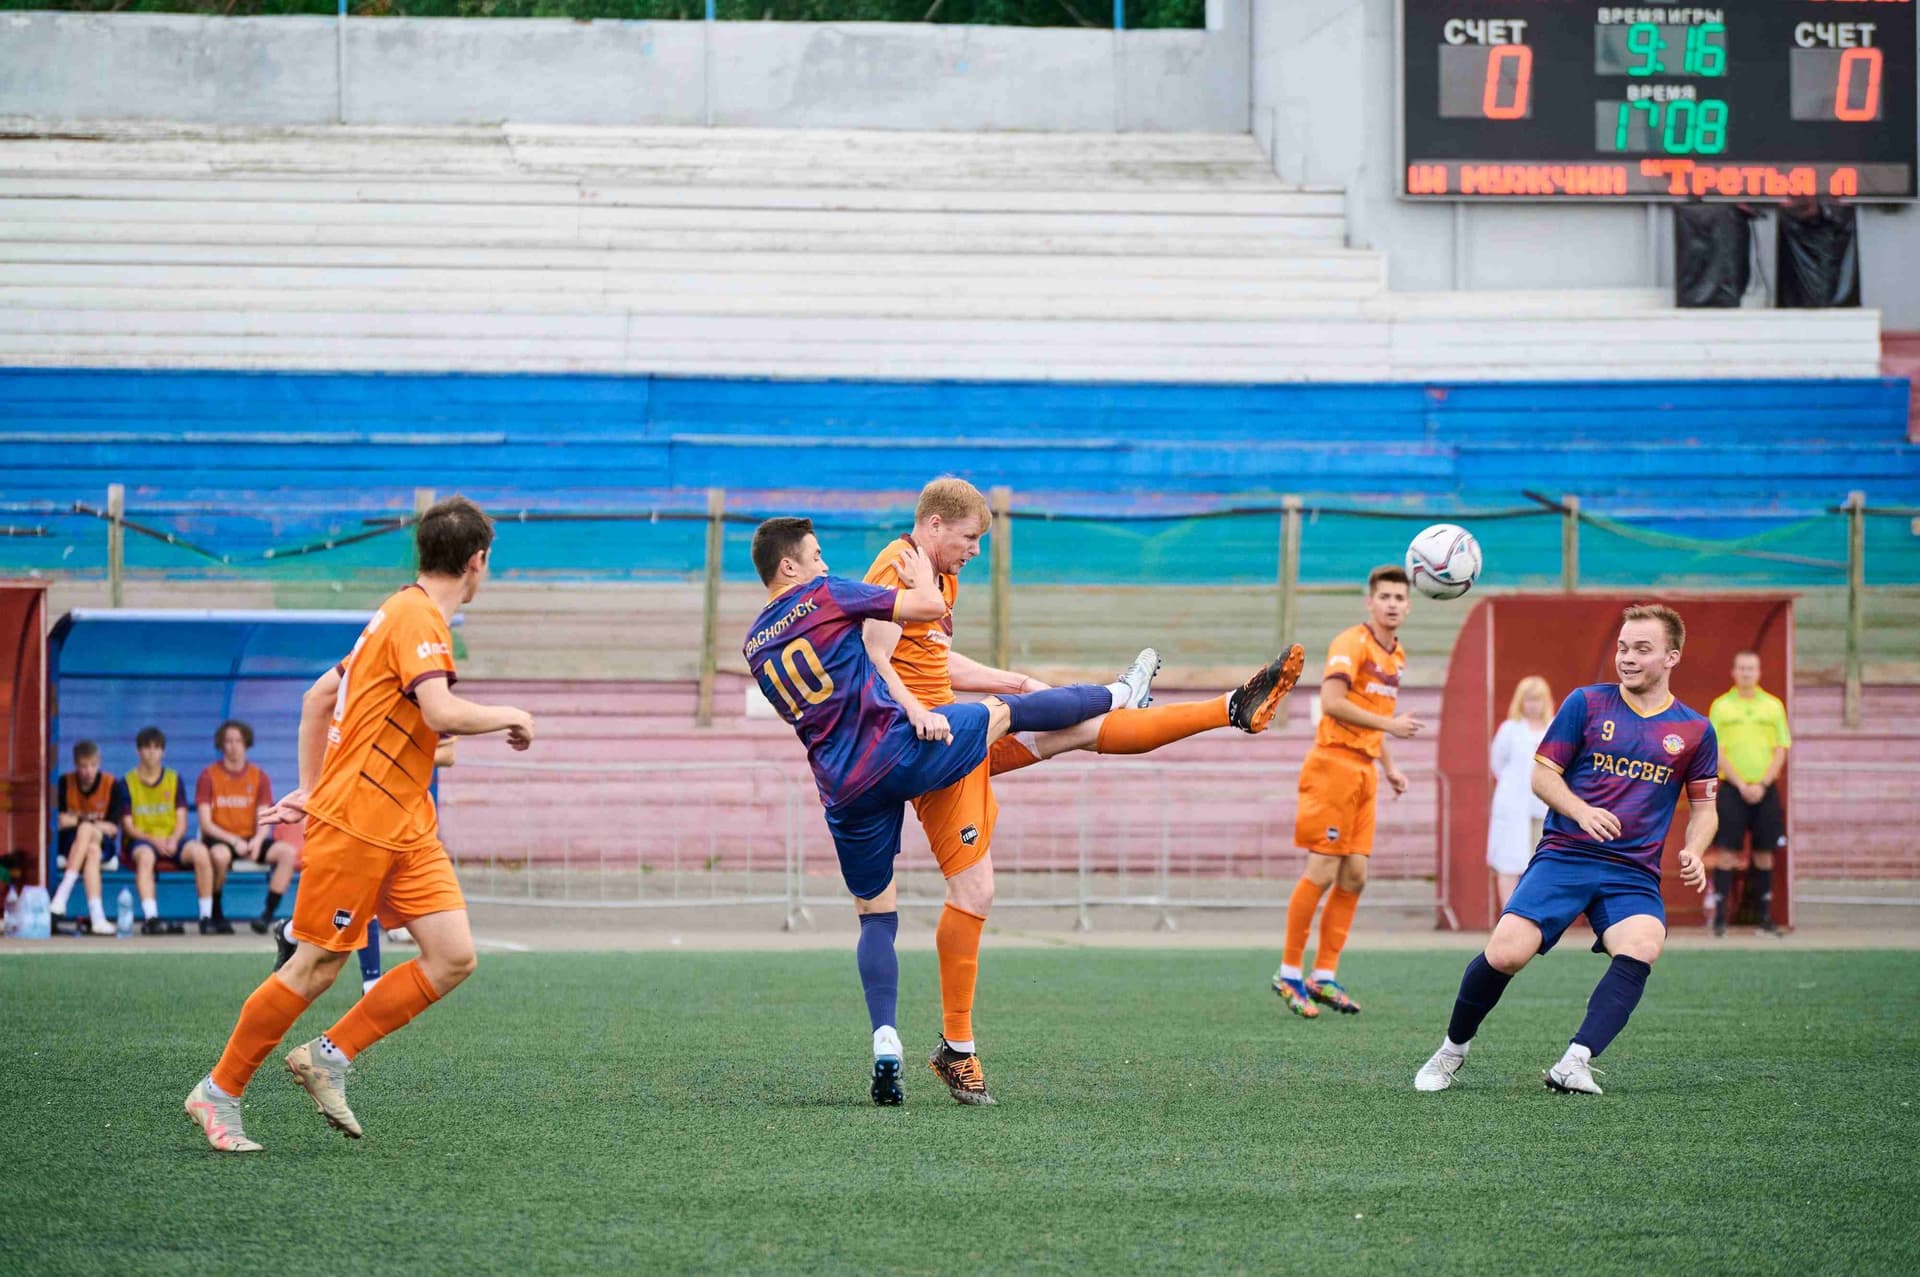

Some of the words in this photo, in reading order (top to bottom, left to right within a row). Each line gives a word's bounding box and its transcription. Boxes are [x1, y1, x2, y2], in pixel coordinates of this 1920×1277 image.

[1598, 7, 1666, 24] ВРЕМЯ
[1667, 8, 1724, 25] ИГРЫ
[1444, 18, 1528, 45] СЧЕТ
[1794, 21, 1877, 48] СЧЕТ
[1627, 22, 1726, 76] 9:16
[1482, 44, 1533, 119] 0
[1626, 84, 1697, 101] ВРЕМЯ
[1834, 47, 1883, 122] 0
[763, 637, 834, 720] 10
[1601, 720, 1615, 741] 9
[1593, 752, 1674, 785] РАССВЕТ
